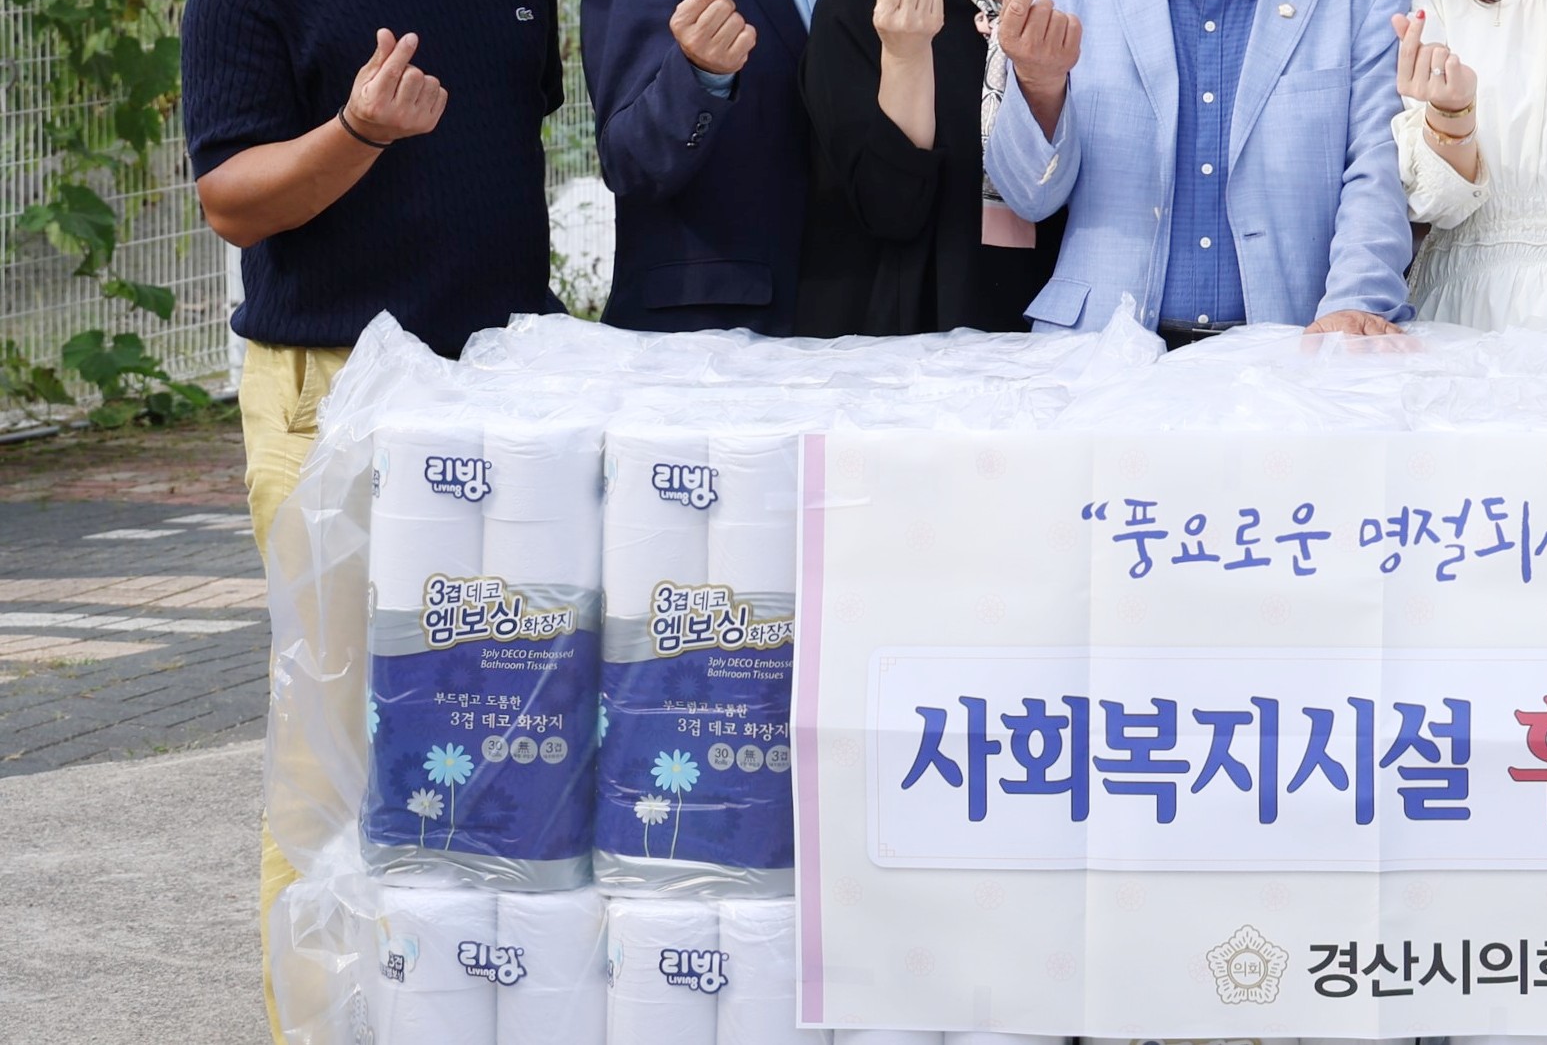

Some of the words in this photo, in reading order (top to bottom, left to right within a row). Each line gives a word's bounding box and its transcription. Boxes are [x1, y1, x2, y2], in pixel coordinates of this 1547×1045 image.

[426, 456, 492, 502] 리빙
[654, 463, 718, 509] 리빙
[429, 579, 462, 605] 3겹
[466, 582, 501, 603] 데코
[656, 587, 689, 613] 3겹
[693, 590, 728, 611] 데코
[426, 598, 521, 644] 엠보싱
[522, 611, 573, 635] 화장지
[653, 607, 747, 652] 엠보싱
[481, 649, 500, 660] 3ply
[501, 649, 527, 659] DECO
[528, 648, 574, 659] Embossed
[707, 657, 727, 669] 3ply
[727, 658, 753, 668] DECO
[754, 658, 794, 669] Embosse
[480, 660, 525, 670] Bathroom
[527, 660, 559, 671] Tissues
[707, 668, 751, 679] Bathroom
[753, 670, 784, 680] Tissues
[434, 692, 481, 707] 부드럽고
[485, 694, 522, 710] 도톰한
[663, 700, 709, 714] 부드럽고
[450, 712, 475, 730] 3겹
[482, 714, 512, 729] 데코
[517, 714, 563, 733] 화장지
[677, 718, 701, 737] 3겹
[708, 721, 738, 737] 데코
[743, 721, 789, 742] 화장지
[545, 742, 562, 754] 3겹
[714, 748, 729, 759] 30
[771, 751, 788, 762] 3겹
[899, 695, 1472, 826] 사회복지시설
[458, 941, 527, 987] 리빙
[660, 949, 730, 995] 리빙
[1233, 960, 1262, 978] 의회
